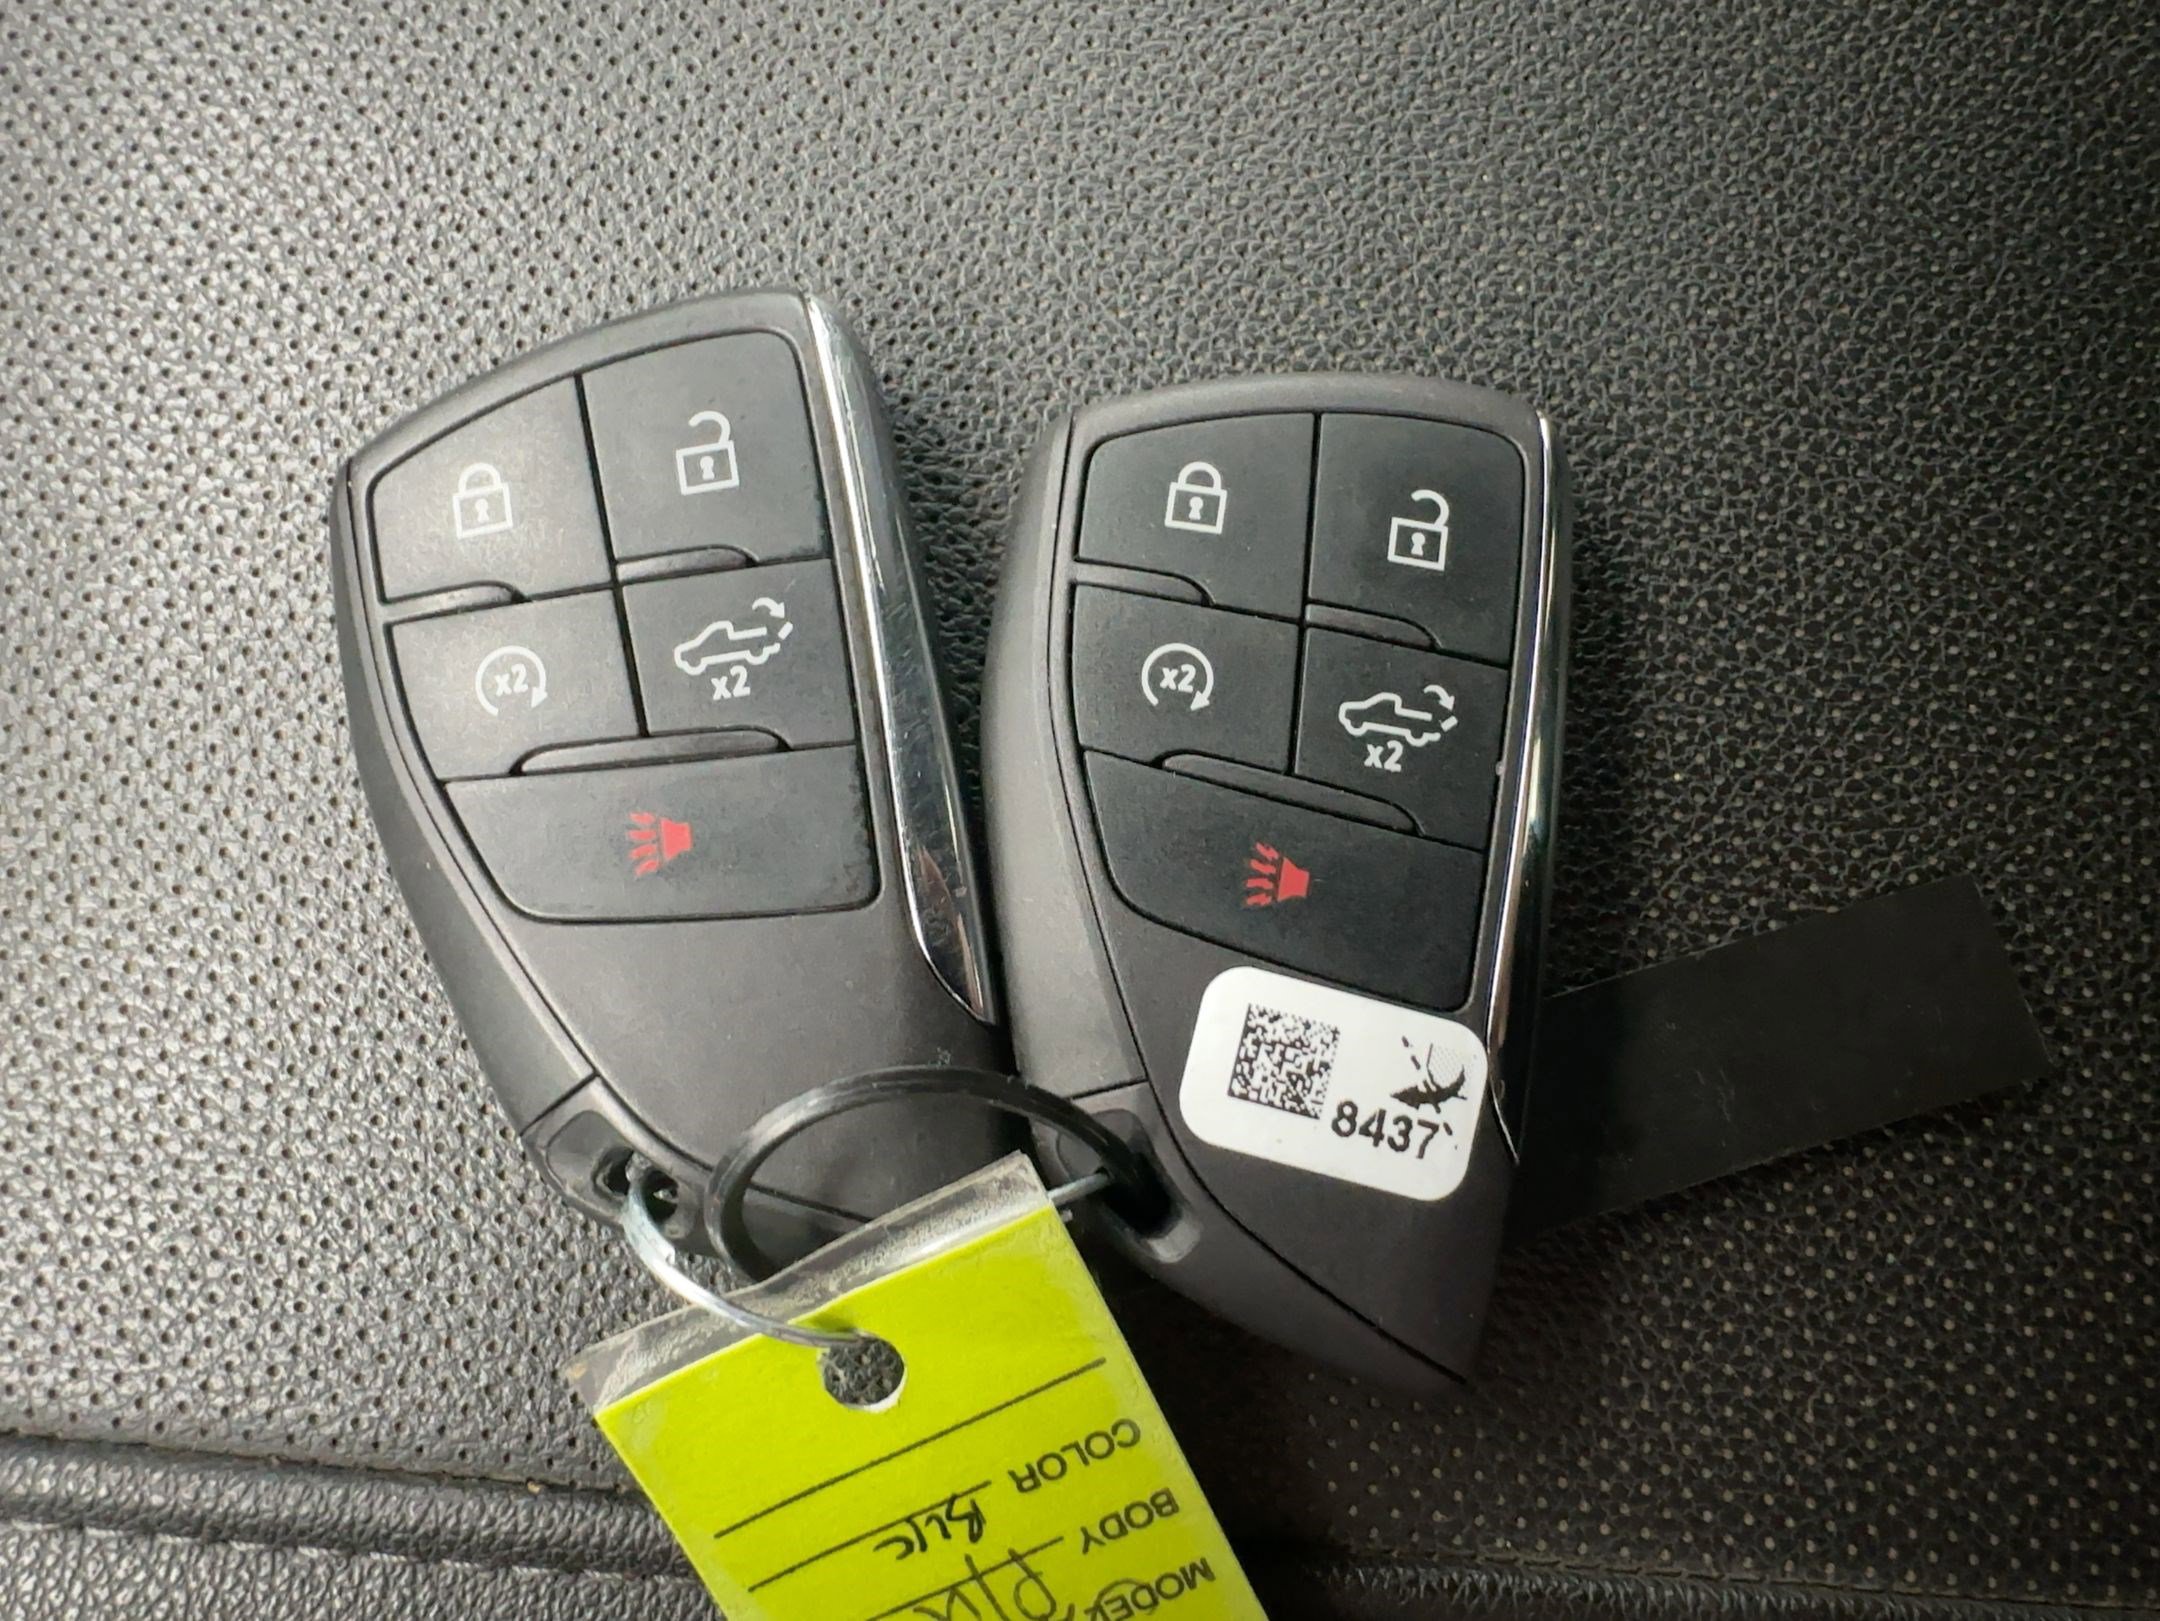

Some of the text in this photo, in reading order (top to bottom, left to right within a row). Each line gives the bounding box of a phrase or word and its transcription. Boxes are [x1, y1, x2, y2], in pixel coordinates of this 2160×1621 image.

[495, 664, 529, 696] x2
[710, 665, 750, 700] x2
[1160, 664, 1196, 693] x2
[1364, 740, 1404, 772] x2
[1331, 1099, 1440, 1160] 8437
[1007, 1418, 1141, 1494] COLOR
[1080, 1487, 1180, 1555] BODY
